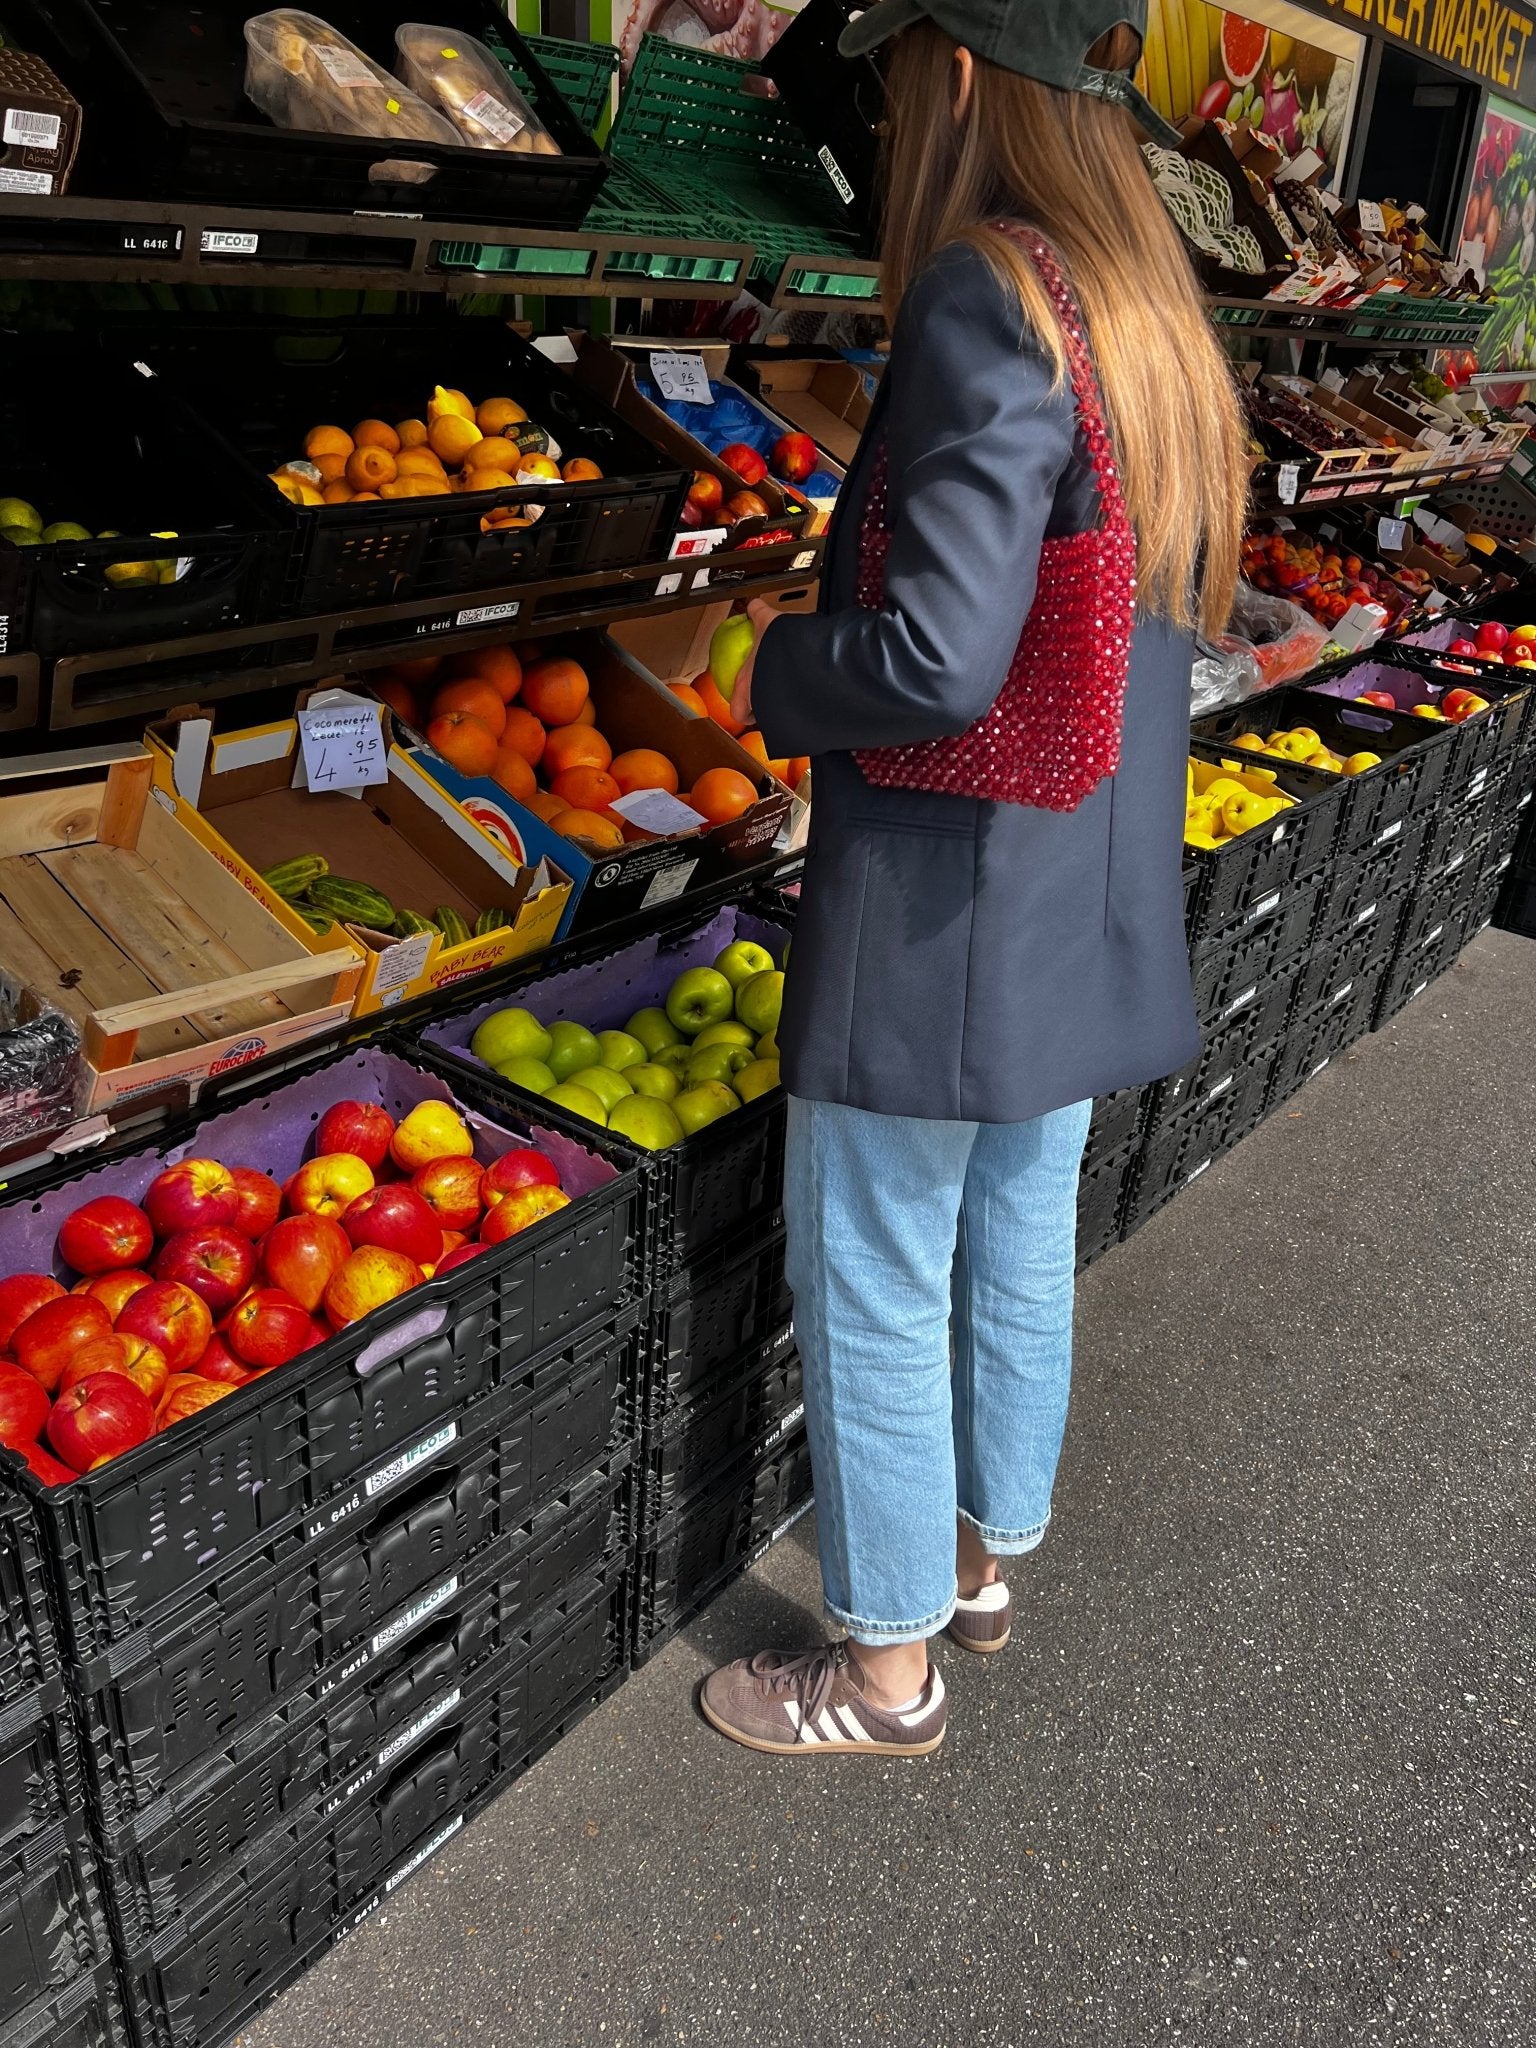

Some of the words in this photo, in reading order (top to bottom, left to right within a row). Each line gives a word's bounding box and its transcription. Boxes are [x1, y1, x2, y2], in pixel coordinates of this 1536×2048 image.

[1428, 0, 1534, 91] MARKET
[28, 153, 55, 165] Aprox
[124, 238, 136, 249] LL
[143, 239, 168, 249] 6416
[213, 234, 242, 247] IFCO
[660, 372, 673, 394] 5
[681, 373, 695, 383] 95
[484, 605, 507, 617] IFCO
[416, 626, 426, 634] LL
[431, 620, 451, 631] 6416
[303, 712, 374, 731] Cocomeretti
[314, 748, 337, 782] 4
[358, 766, 369, 777] kg
[430, 954, 469, 983] BABY
[471, 945, 506, 962] BEAR
[762, 1346, 770, 1357] LL
[774, 1330, 789, 1348] 6416
[407, 1435, 437, 1463] IFCO
[754, 1446, 761, 1456] LL
[309, 1521, 325, 1537] LL
[331, 1495, 360, 1522] 6416
[410, 1592, 439, 1618] IFCO
[321, 1680, 335, 1695] LL
[341, 1652, 369, 1679] 6416
[327, 1797, 341, 1812] LL
[346, 1769, 373, 1795] 6413
[336, 1926, 350, 1940] LL
[354, 1896, 379, 1924] 6416
